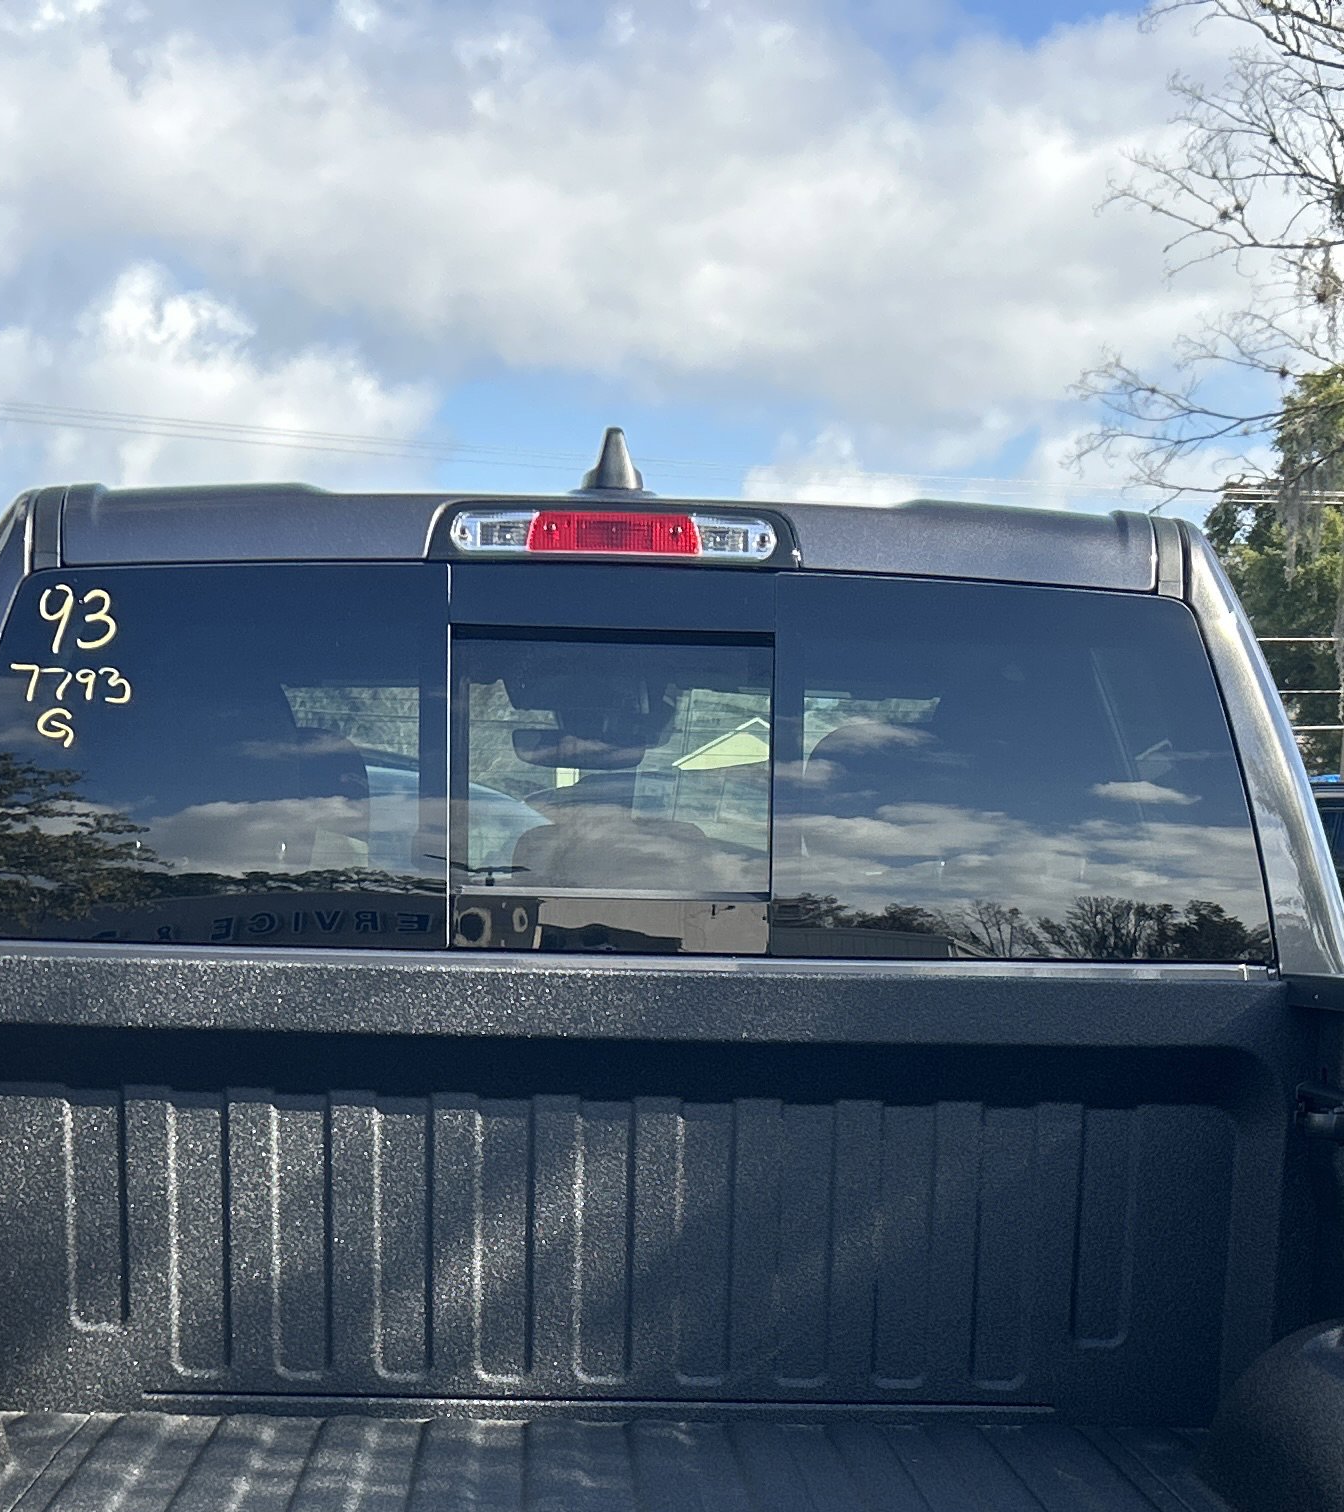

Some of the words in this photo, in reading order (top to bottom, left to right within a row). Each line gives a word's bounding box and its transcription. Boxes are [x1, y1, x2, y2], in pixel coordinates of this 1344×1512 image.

[39, 584, 117, 654] 93
[10, 663, 132, 704] 7793
[36, 707, 74, 747] G
